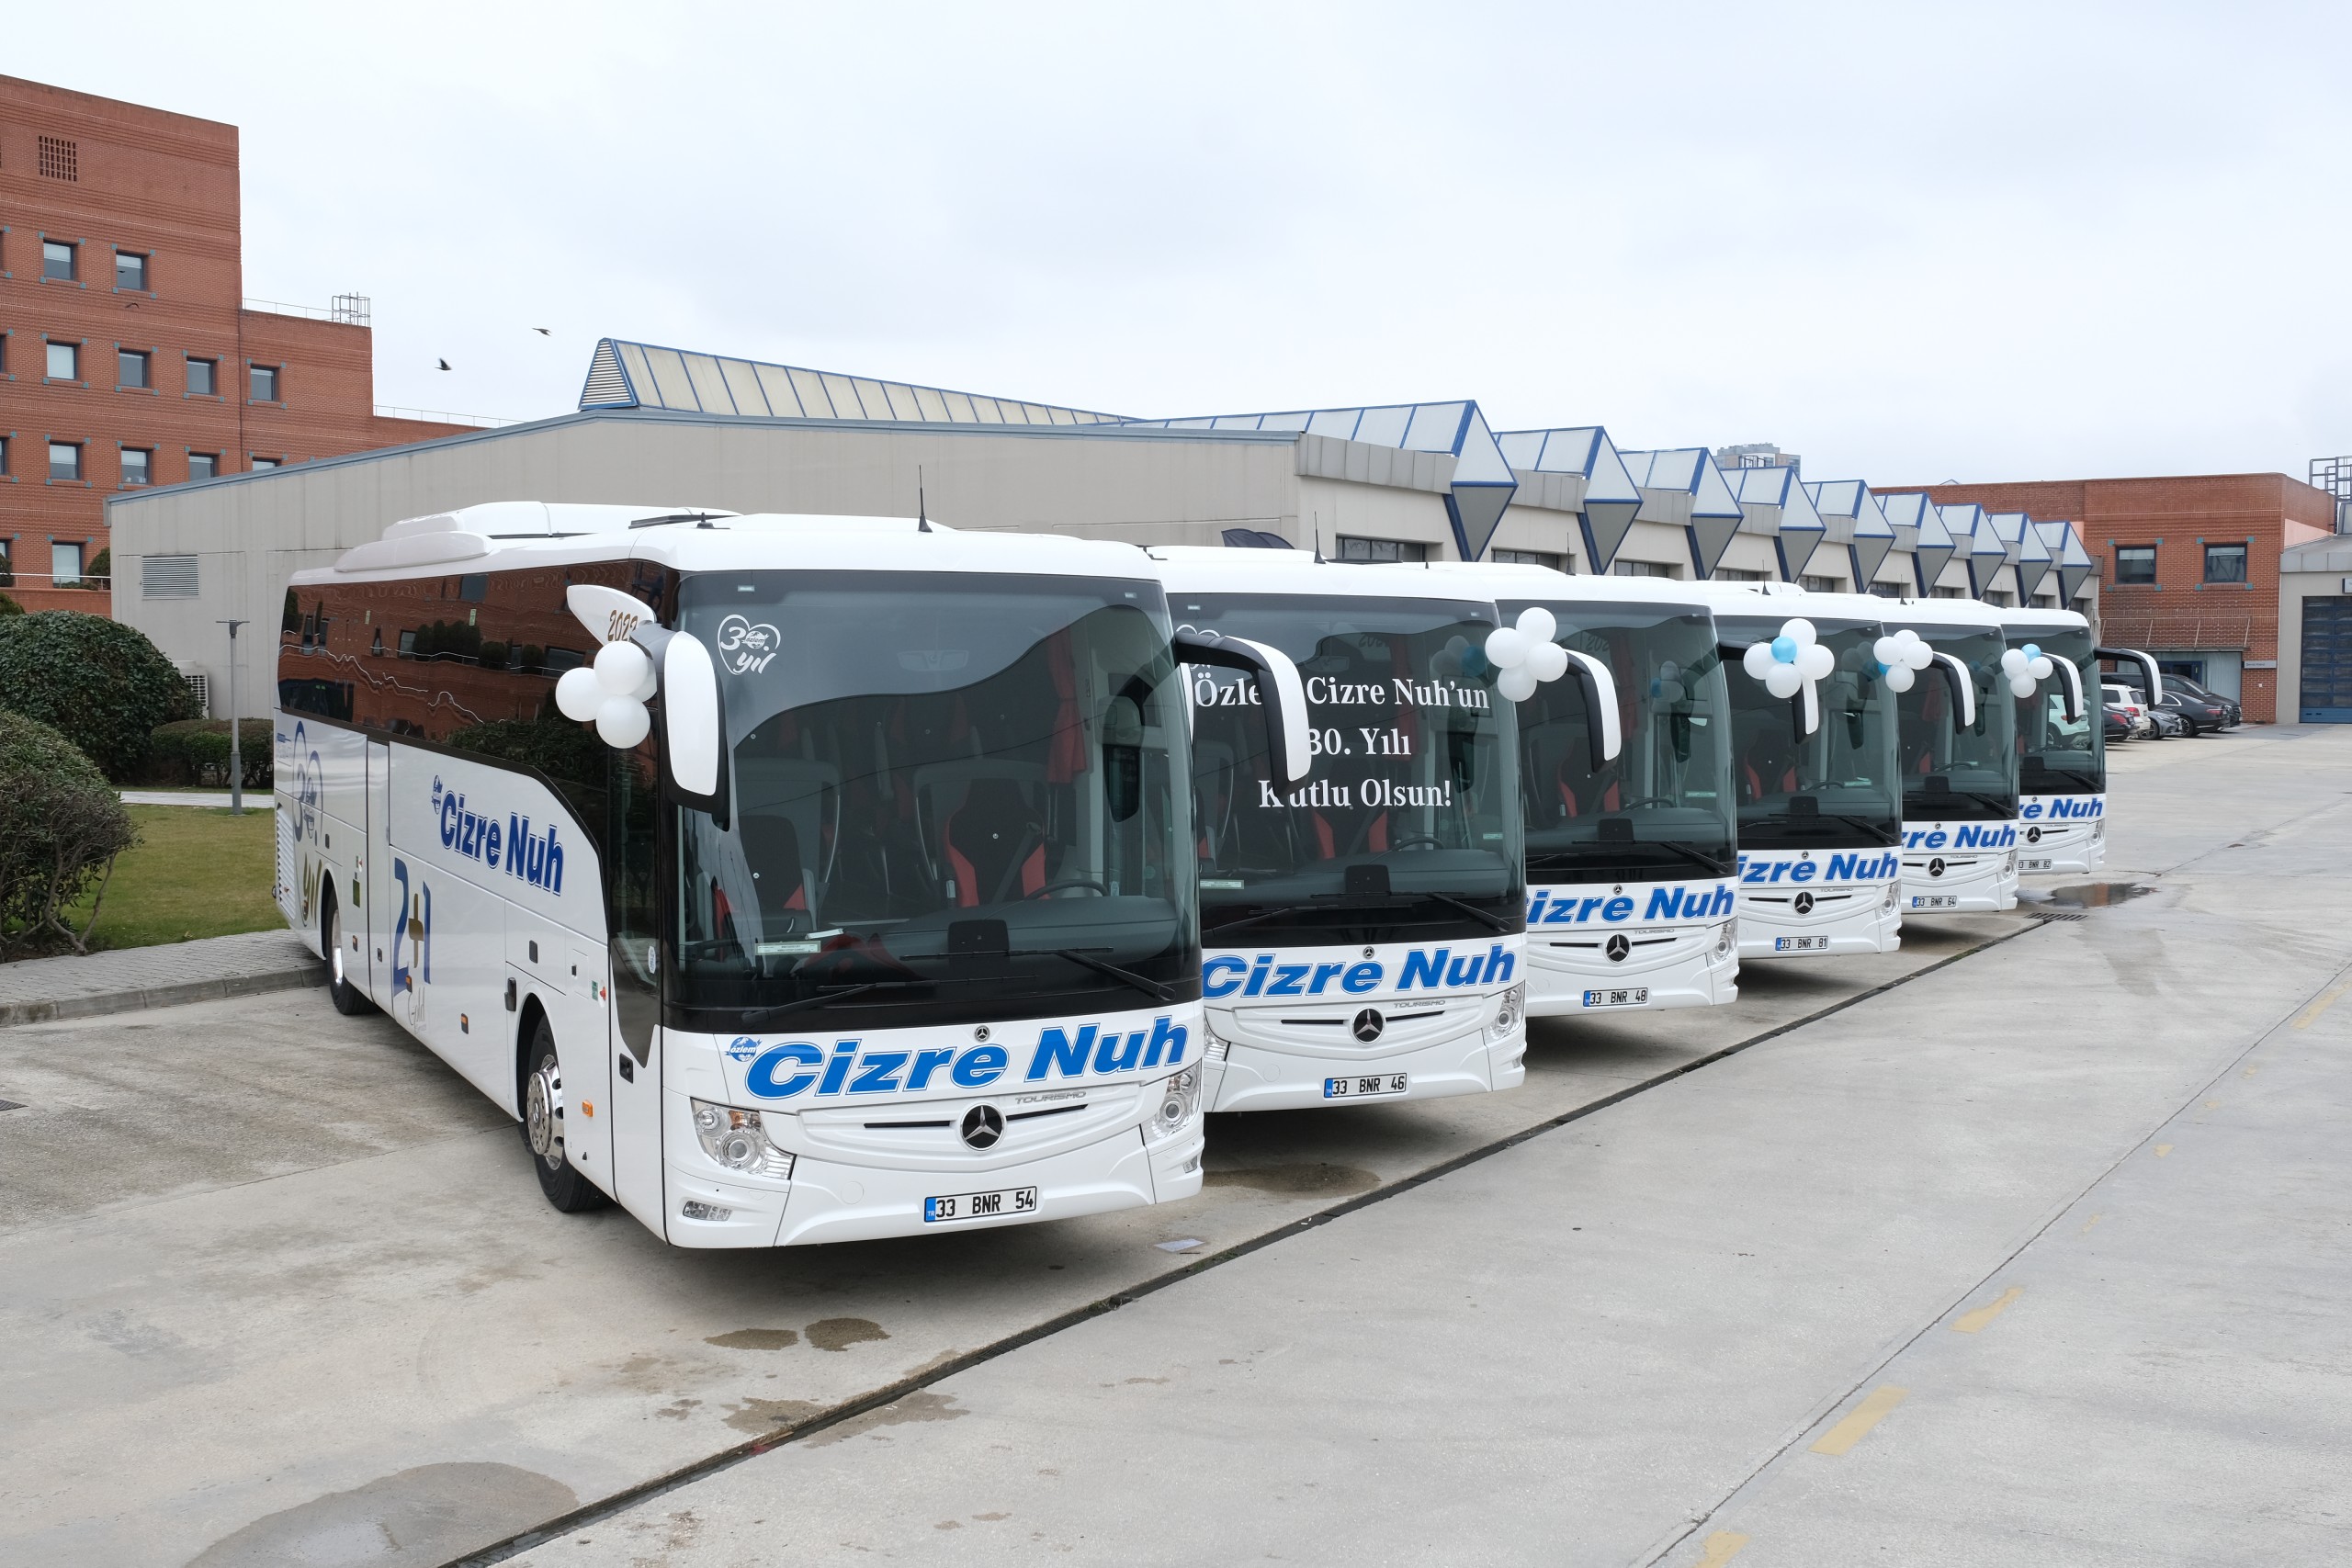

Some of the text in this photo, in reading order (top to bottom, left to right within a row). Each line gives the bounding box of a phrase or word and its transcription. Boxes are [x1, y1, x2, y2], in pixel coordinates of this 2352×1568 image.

[1194, 671, 1490, 710] Özle Cizre Nuh'un
[1308, 728, 1412, 756] 30. Yılı
[1258, 779, 1453, 808] Kutlu Olsun!
[2048, 797, 2104, 819] Nuh
[440, 790, 564, 897] Cizre Nuh
[1953, 823, 2018, 850] Nuh
[1737, 851, 1899, 885] izre Nuh
[1526, 884, 1736, 925] izre Nuh
[1781, 939, 1791, 949] 33
[1797, 938, 1812, 949] BNR
[1203, 942, 1517, 1000] Cizre Nuh
[1589, 989, 1646, 1005] 33 BNR 48
[745, 1015, 1192, 1101] Cizre Nuh
[1014, 1090, 1087, 1105] TOURISMO
[1332, 1079, 1348, 1095] 33
[1358, 1077, 1381, 1093] BNR
[1390, 1076, 1405, 1090] 46
[935, 1198, 956, 1219] 33
[971, 1193, 1001, 1215] BNR
[1014, 1190, 1035, 1210] 54
